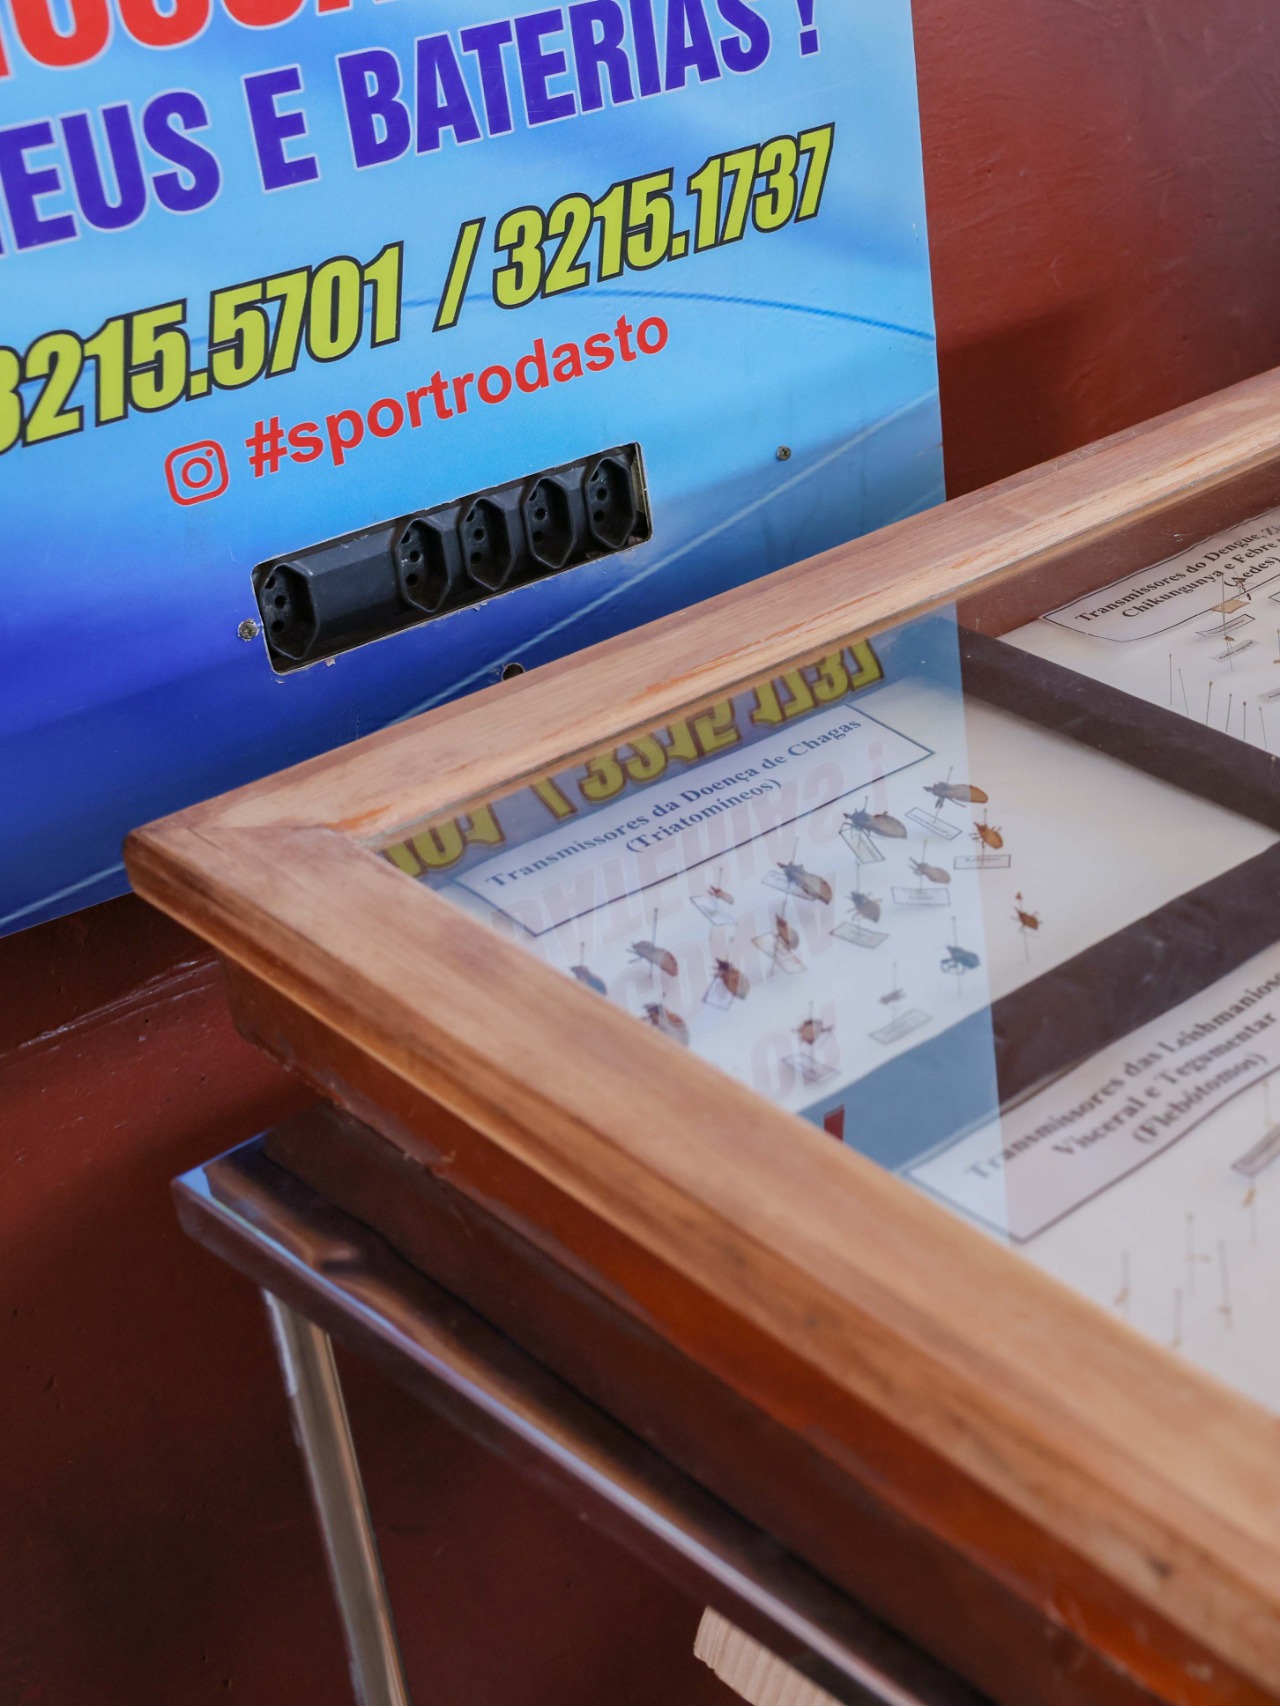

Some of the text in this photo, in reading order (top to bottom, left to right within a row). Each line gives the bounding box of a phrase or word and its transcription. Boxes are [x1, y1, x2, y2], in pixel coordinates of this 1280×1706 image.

[0, 90, 221, 256] EUS
[243, 64, 319, 192] E
[336, 0, 771, 169] BATERIAS
[492, 122, 836, 310] 3215.1737
[245, 314, 669, 479] #sportrodasto
[1074, 570, 1186, 623] Transmissores
[1186, 559, 1207, 576] do
[1203, 532, 1265, 563] Dengue,
[1121, 568, 1225, 620] Chikungunya
[1224, 559, 1236, 571] e
[1233, 540, 1279, 565] Febre
[486, 720, 862, 887] Transmissores da Doença de Chagas
[1143, 1085, 1161, 1099] e
